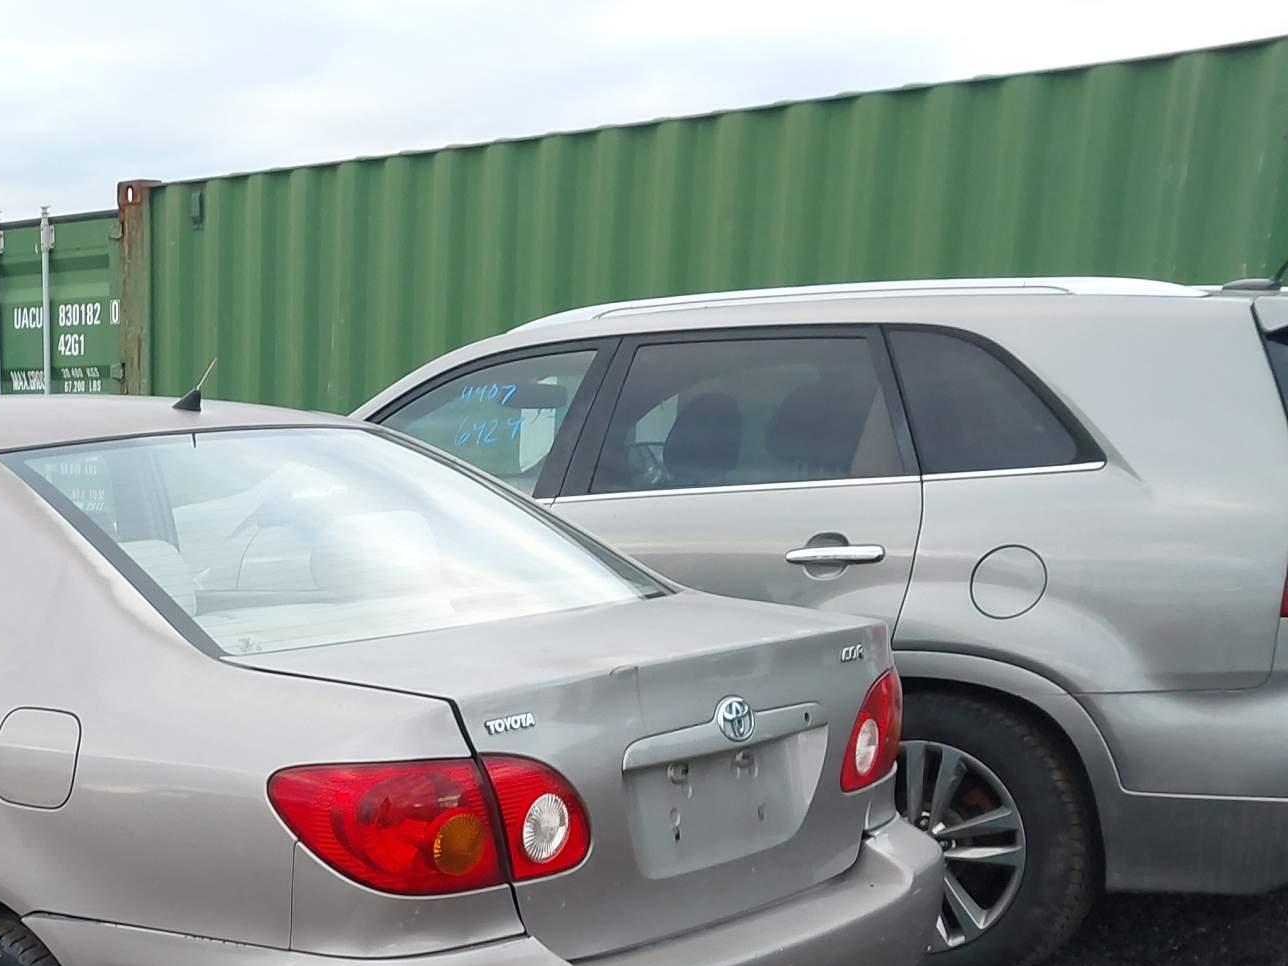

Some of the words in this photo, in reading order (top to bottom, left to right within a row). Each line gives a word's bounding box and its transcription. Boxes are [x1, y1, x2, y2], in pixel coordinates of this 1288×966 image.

[14, 307, 43, 329] UACU
[58, 302, 101, 326] 830182
[111, 300, 120, 324] 0
[58, 334, 85, 356] 42G1
[485, 712, 536, 735] TOYOTA
